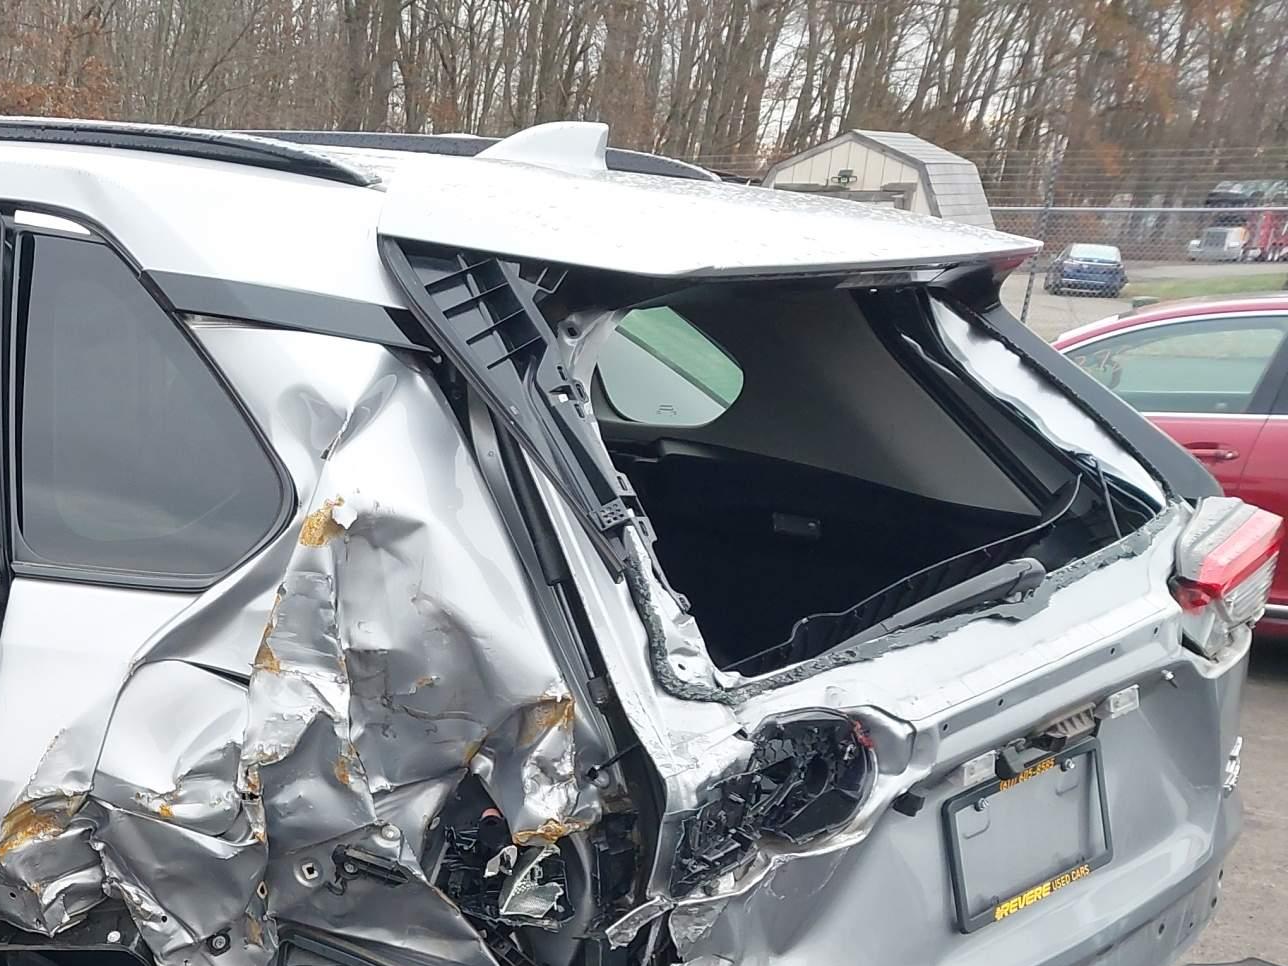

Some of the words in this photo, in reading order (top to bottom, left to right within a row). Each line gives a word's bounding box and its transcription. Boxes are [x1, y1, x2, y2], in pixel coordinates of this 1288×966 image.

[1001, 882, 1051, 917] REVERE
[1052, 874, 1071, 891] USED
[1072, 864, 1090, 881] CARS
